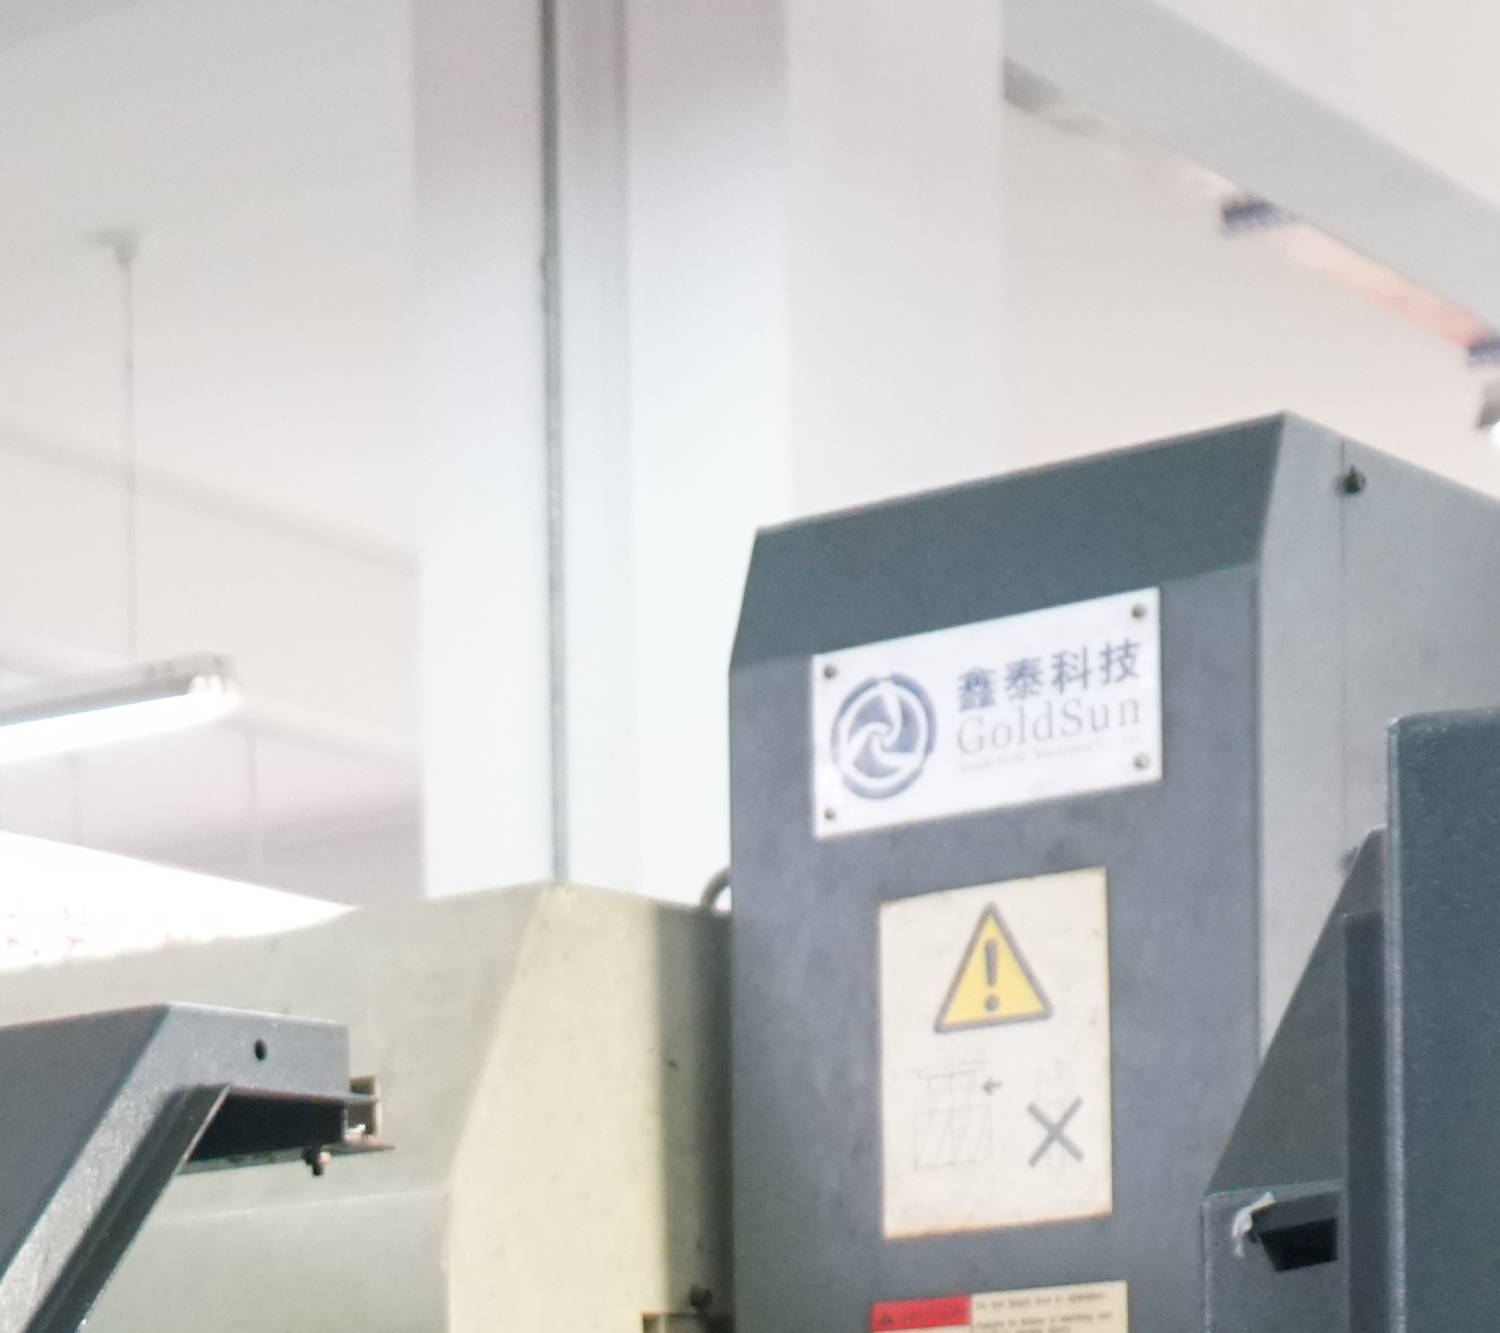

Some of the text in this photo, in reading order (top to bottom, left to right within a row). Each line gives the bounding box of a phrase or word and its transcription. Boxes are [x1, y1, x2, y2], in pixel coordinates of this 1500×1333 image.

[957, 638, 1141, 711] 鑫泰科技
[957, 695, 1141, 756] GoldSun
